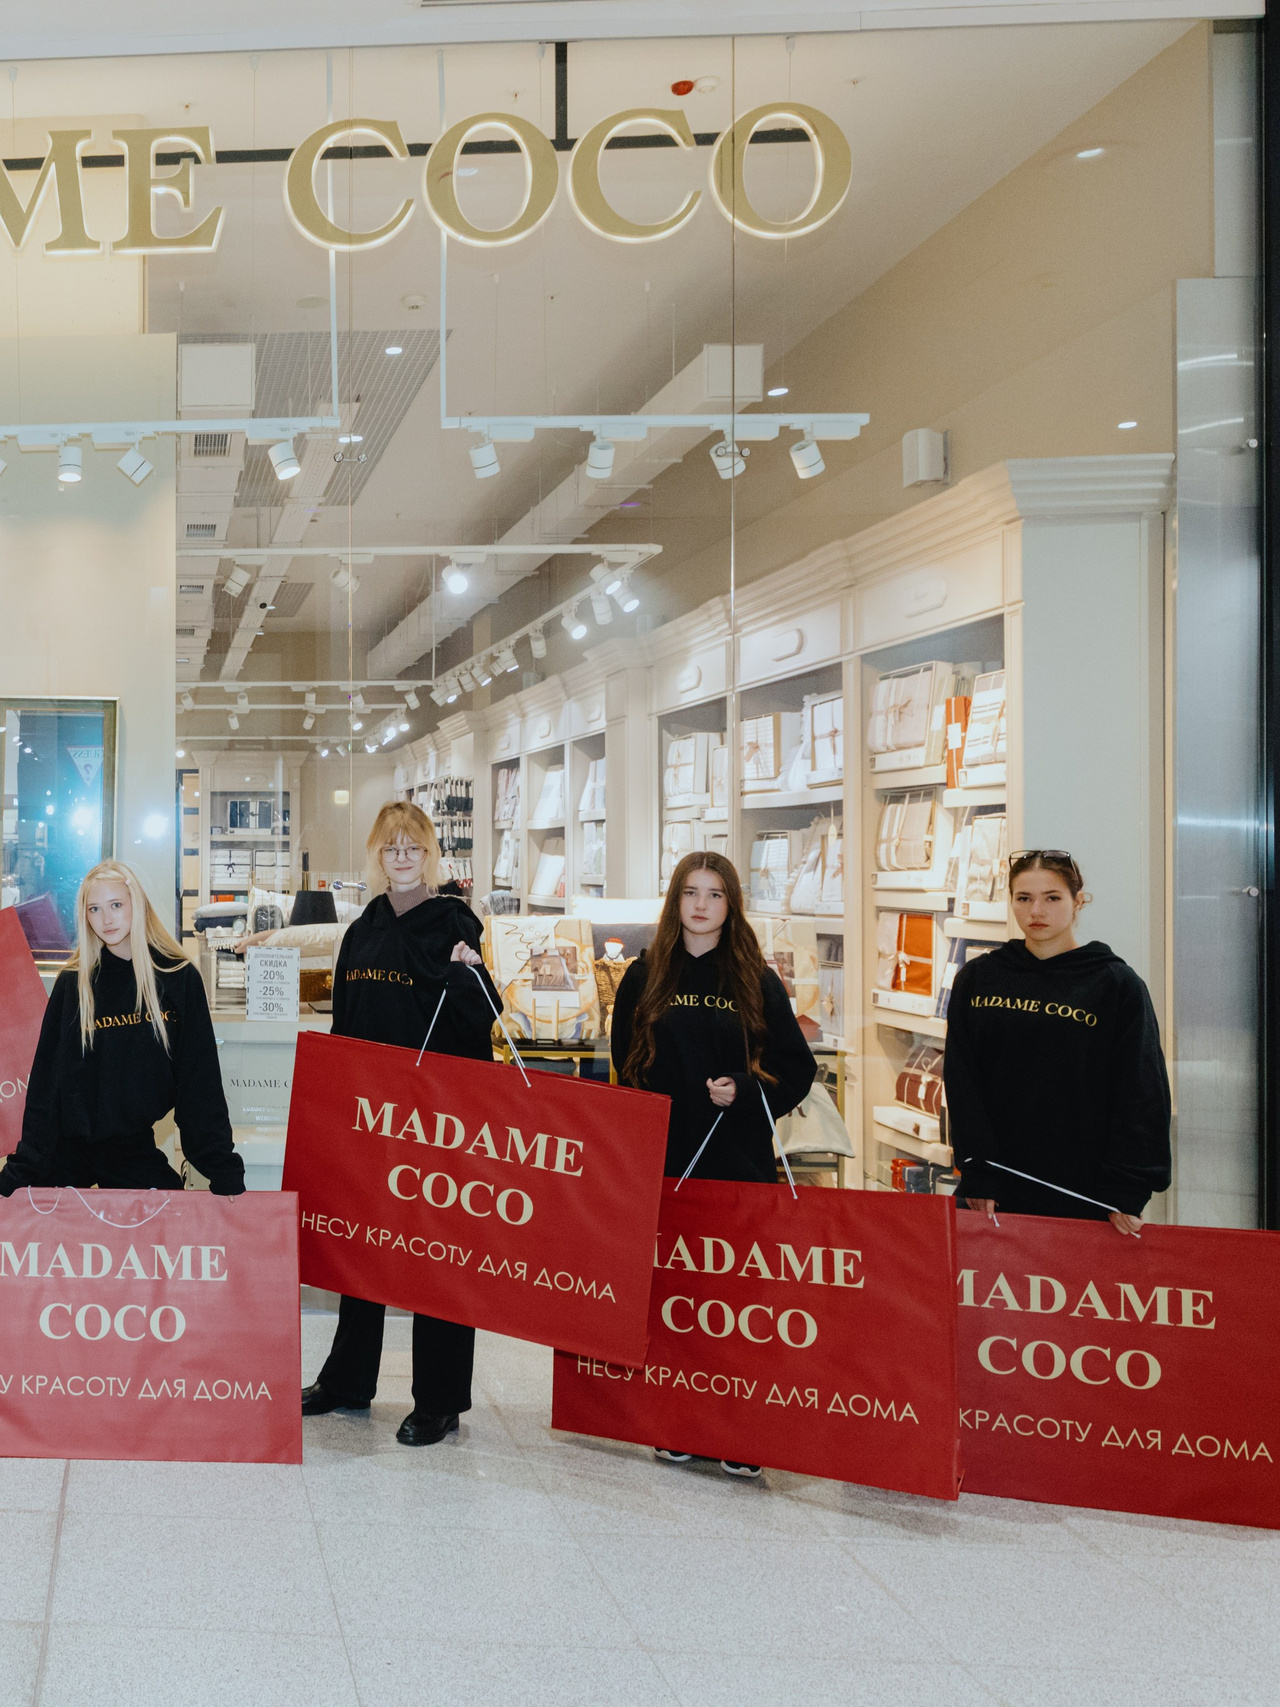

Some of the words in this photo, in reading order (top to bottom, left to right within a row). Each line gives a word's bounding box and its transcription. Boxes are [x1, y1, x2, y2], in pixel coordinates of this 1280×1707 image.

[283, 102, 853, 251] COCO
[260, 960, 288, 968] СКИДКА
[260, 970, 285, 980] -20%
[259, 986, 284, 996] -25%
[259, 1002, 284, 1012] -30%
[86, 1012, 142, 1030] ADAME
[1045, 1002, 1098, 1027] COCO
[230, 1079, 281, 1088] MADAME
[352, 1096, 584, 1177] MADAME
[387, 1164, 534, 1225] COCO
[301, 1211, 358, 1239] НЕСУ
[365, 1226, 472, 1266] КРАСОТУ
[477, 1254, 527, 1281] ДЛЯ
[533, 1267, 616, 1303] ДОМА
[39, 1303, 186, 1342] COCO
[661, 1295, 818, 1348] COCO
[977, 1335, 1161, 1390] COCO
[21, 1375, 131, 1397] КРАСОТУ
[138, 1379, 186, 1400] ДЛЯ
[194, 1379, 272, 1401] ДОМА
[644, 1364, 757, 1399] КРАСОТУ
[766, 1383, 818, 1409] ДЛЯ
[827, 1392, 919, 1424] ДОМА
[959, 1407, 1092, 1442] КРАСОТУ
[1101, 1425, 1161, 1450] ДЛЯ
[1172, 1433, 1273, 1463] ДОМА
